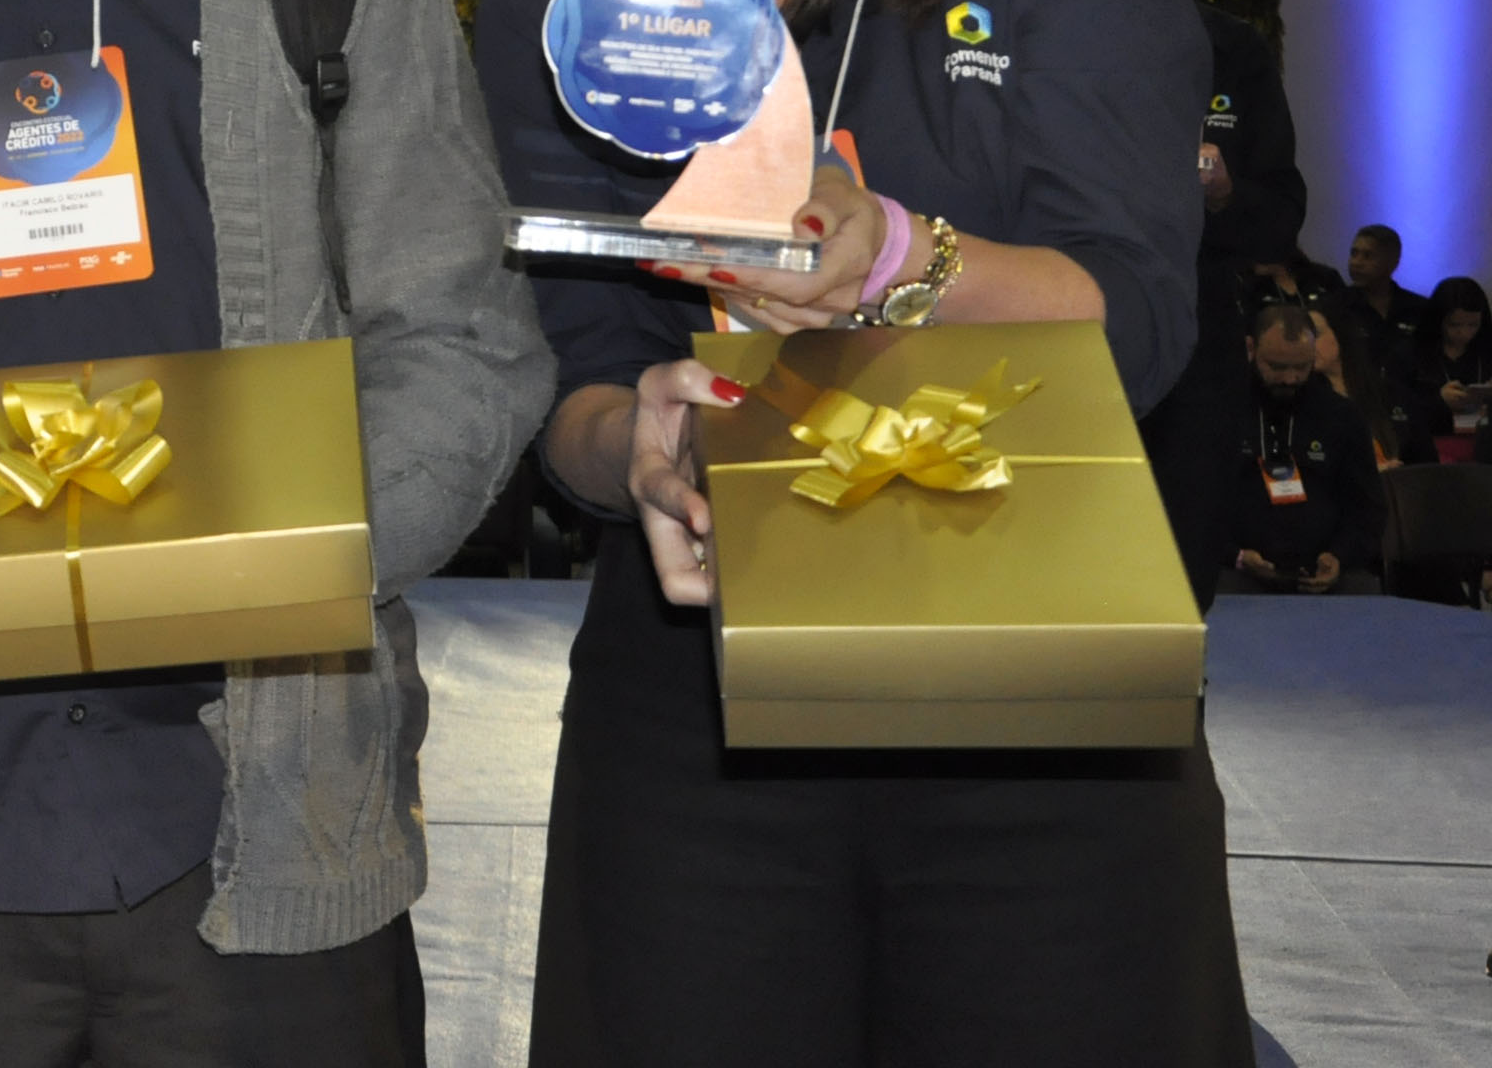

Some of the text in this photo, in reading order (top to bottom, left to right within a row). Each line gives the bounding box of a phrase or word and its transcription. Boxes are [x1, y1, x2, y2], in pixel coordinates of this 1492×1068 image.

[644, 14, 712, 37] LUGAR
[945, 49, 1010, 73] Fomento
[951, 65, 1002, 86] Paraná
[8, 119, 80, 139] AGENTES DE
